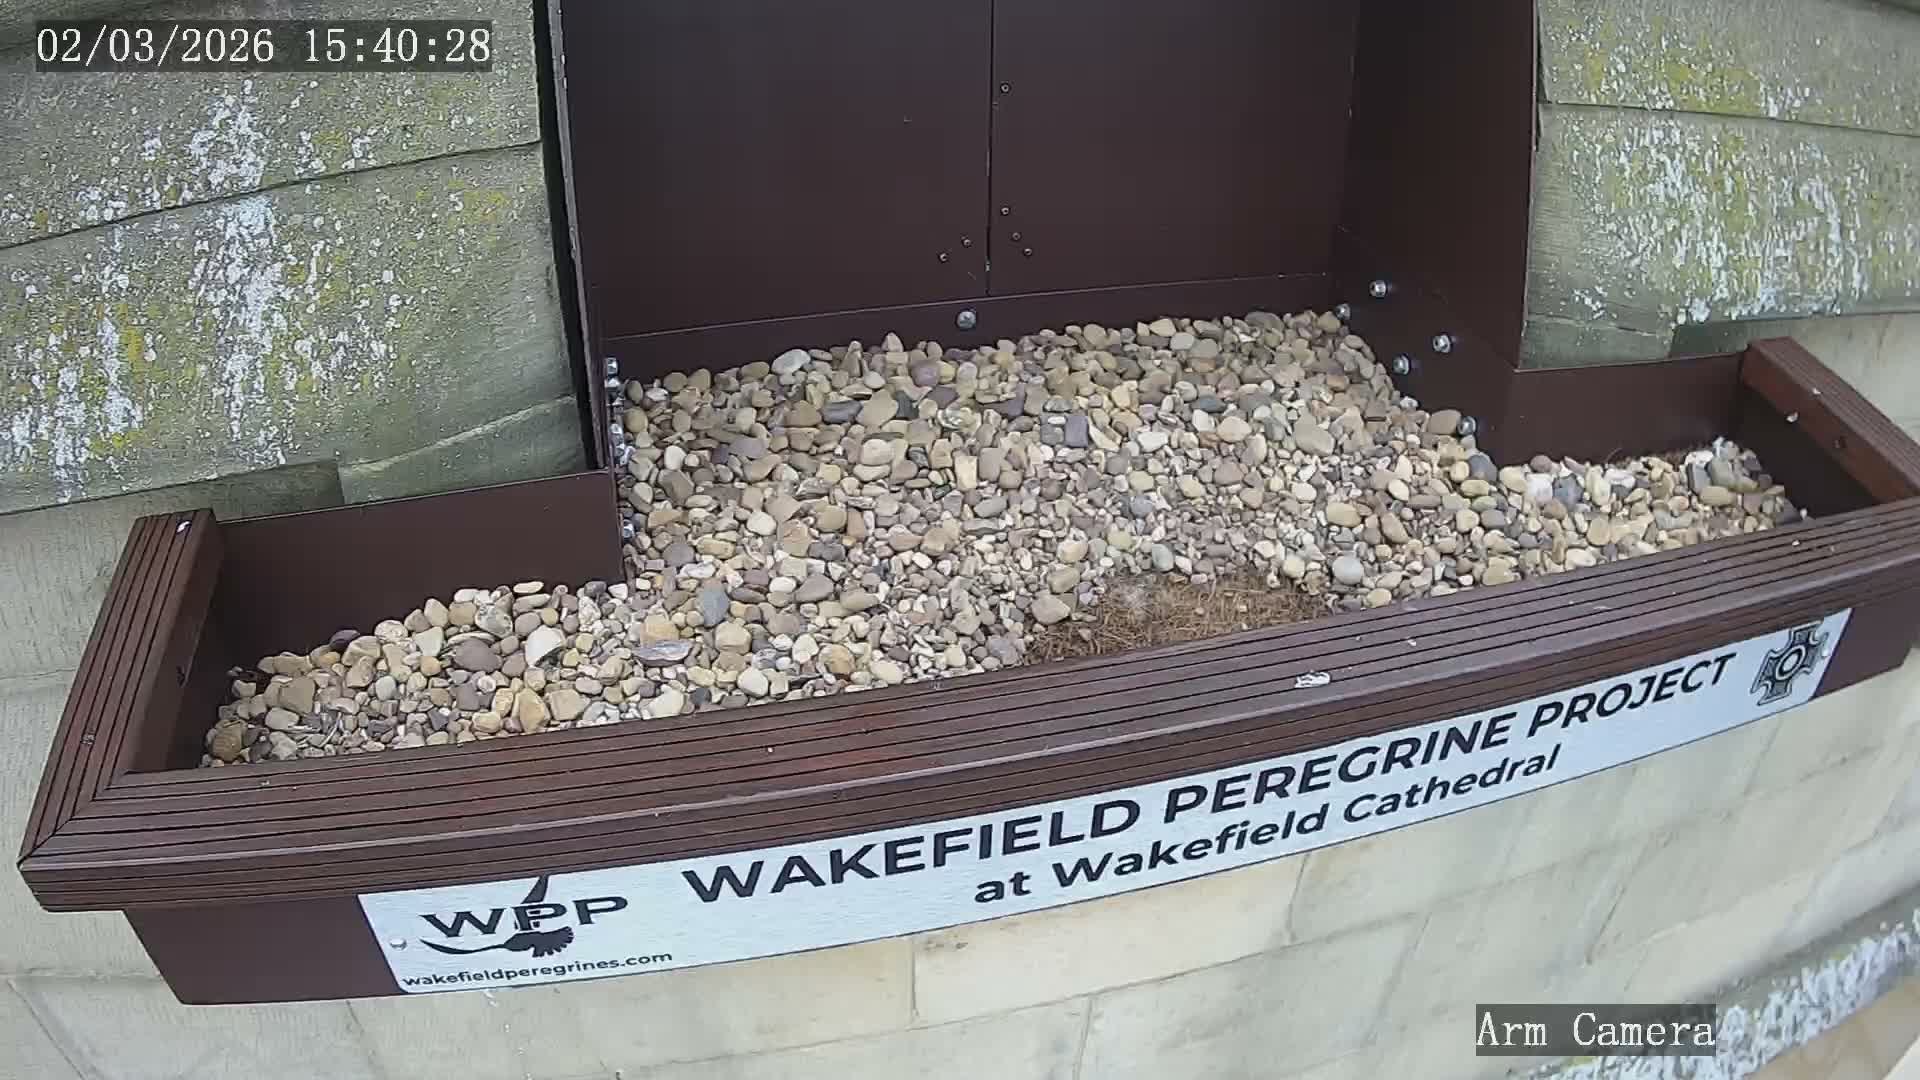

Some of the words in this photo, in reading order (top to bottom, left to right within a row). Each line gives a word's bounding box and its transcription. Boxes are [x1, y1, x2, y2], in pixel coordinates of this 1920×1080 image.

[682, 799, 1141, 903] WAKEFIELD
[1163, 711, 1517, 823] PEREGRINE
[1527, 653, 1737, 738] PROJECT
[974, 874, 1032, 903] at
[1052, 803, 1329, 887] Wakefield
[1343, 744, 1562, 824] Cathedral
[419, 896, 628, 938] WPP
[402, 951, 673, 987] wakefieldperegrines.com
